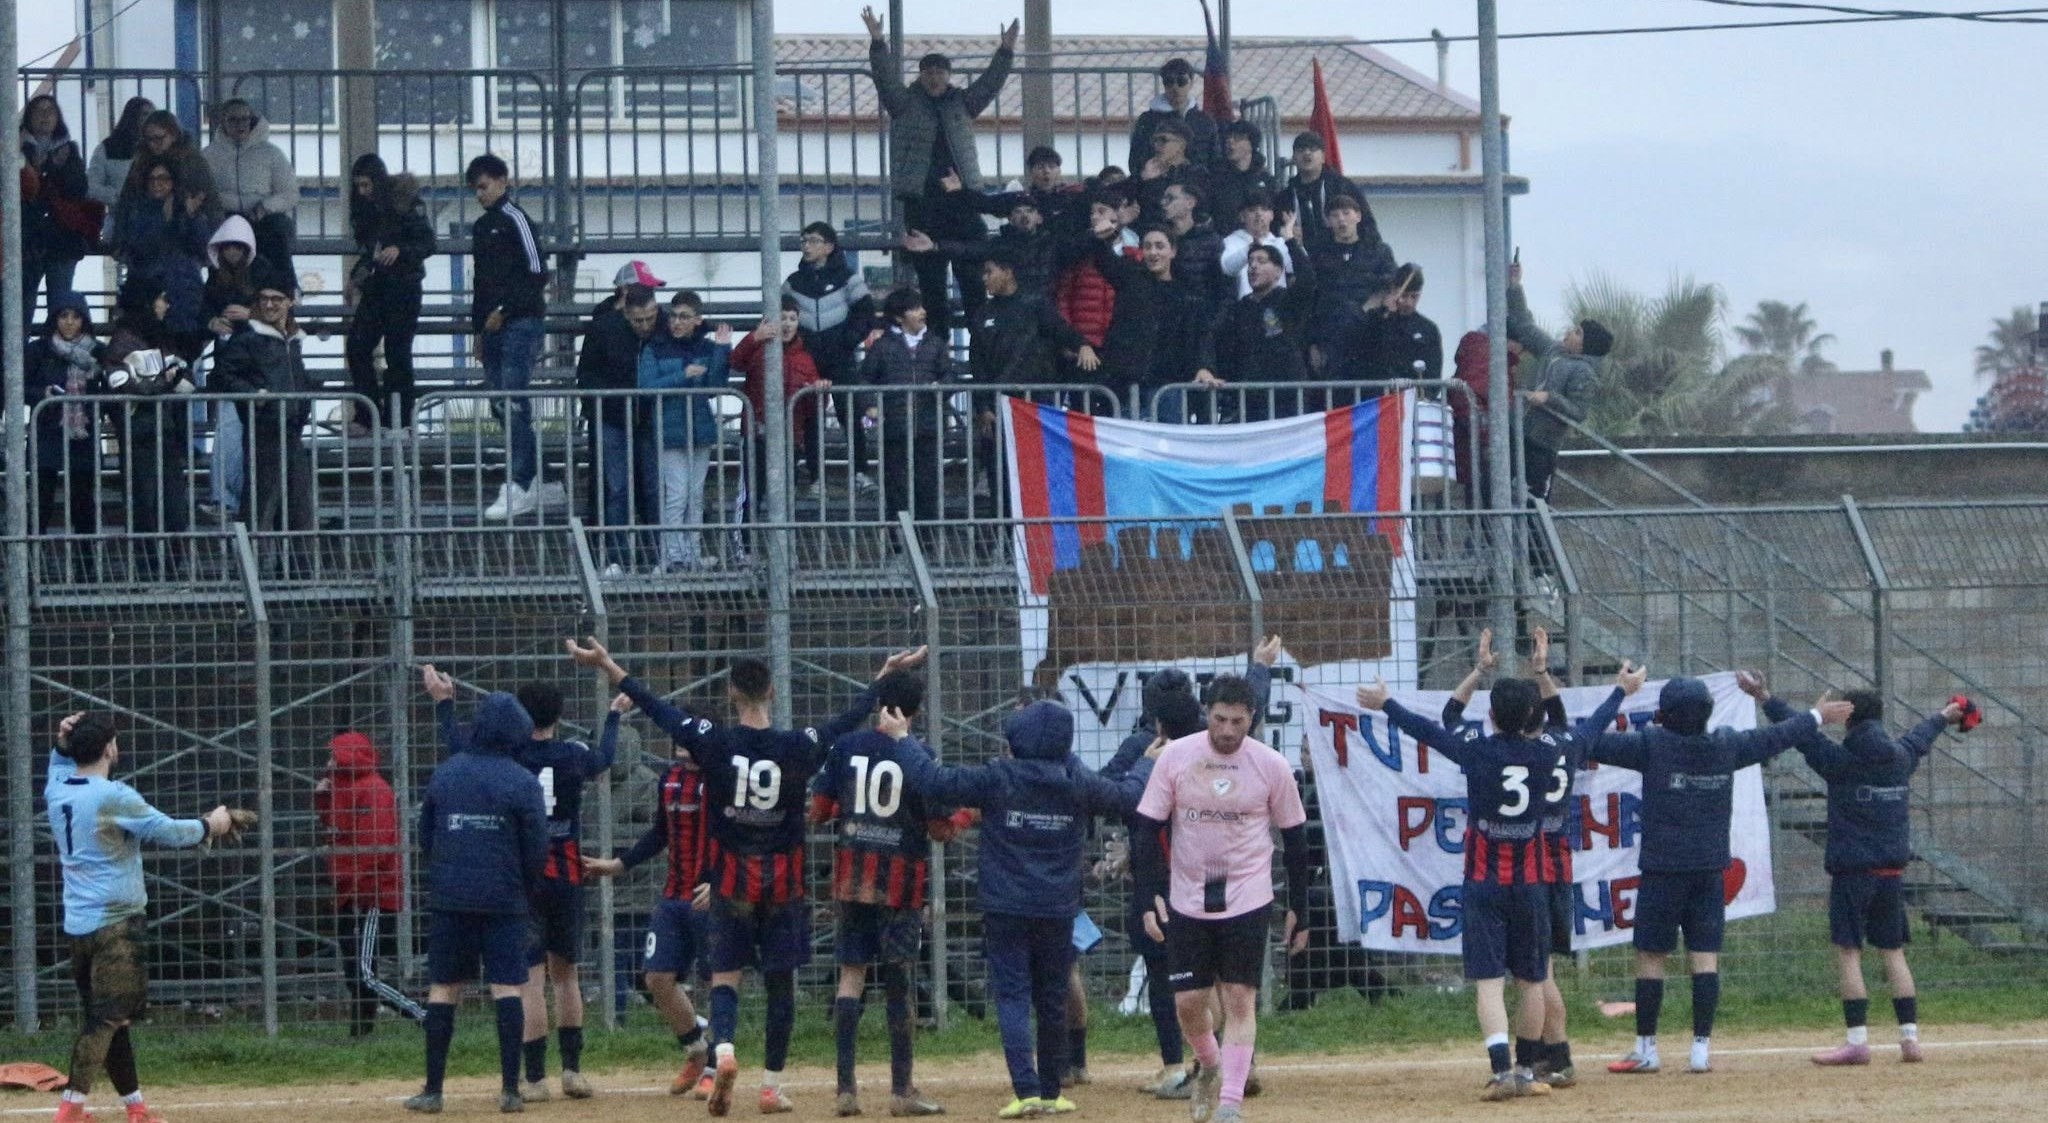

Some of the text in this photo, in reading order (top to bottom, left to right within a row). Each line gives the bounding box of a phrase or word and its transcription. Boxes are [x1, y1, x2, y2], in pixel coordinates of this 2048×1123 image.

[731, 754, 782, 810] 19
[849, 755, 904, 818] 10
[1498, 765, 1530, 817] 3
[61, 804, 74, 856] 1
